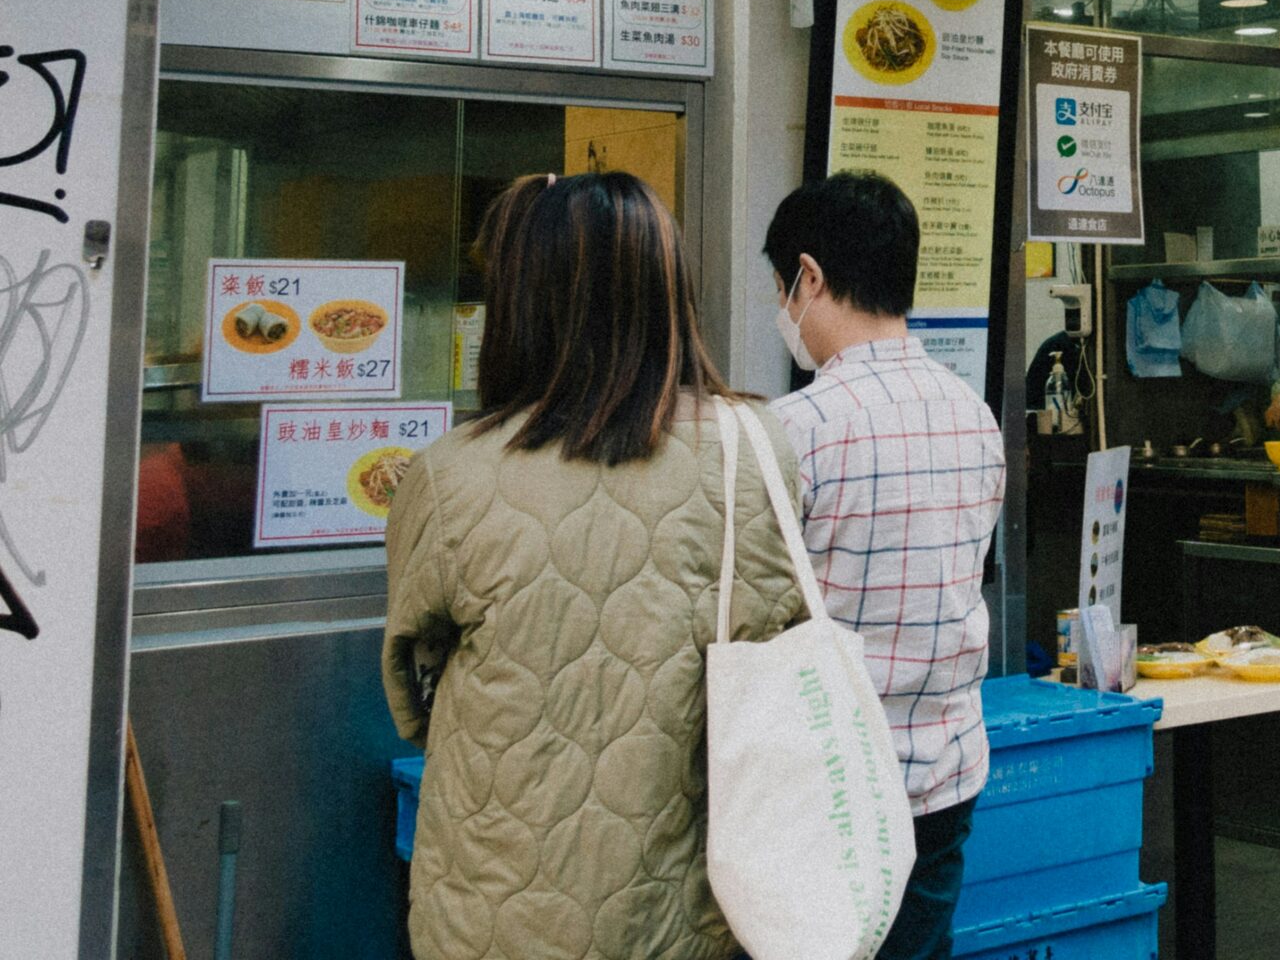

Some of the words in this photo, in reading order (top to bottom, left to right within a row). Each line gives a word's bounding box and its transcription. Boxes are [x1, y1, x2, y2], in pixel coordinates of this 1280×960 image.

[1044, 40, 1125, 63] 本餐廳可使用
[1051, 61, 1118, 84] 政府消費券
[1079, 102, 1113, 119] 支付宝
[1078, 185, 1115, 198] Octopus
[269, 277, 300, 296] $21
[289, 358, 354, 380] 糯米飯
[357, 360, 391, 378] $27
[399, 420, 429, 438] $21
[796, 666, 835, 732] light
